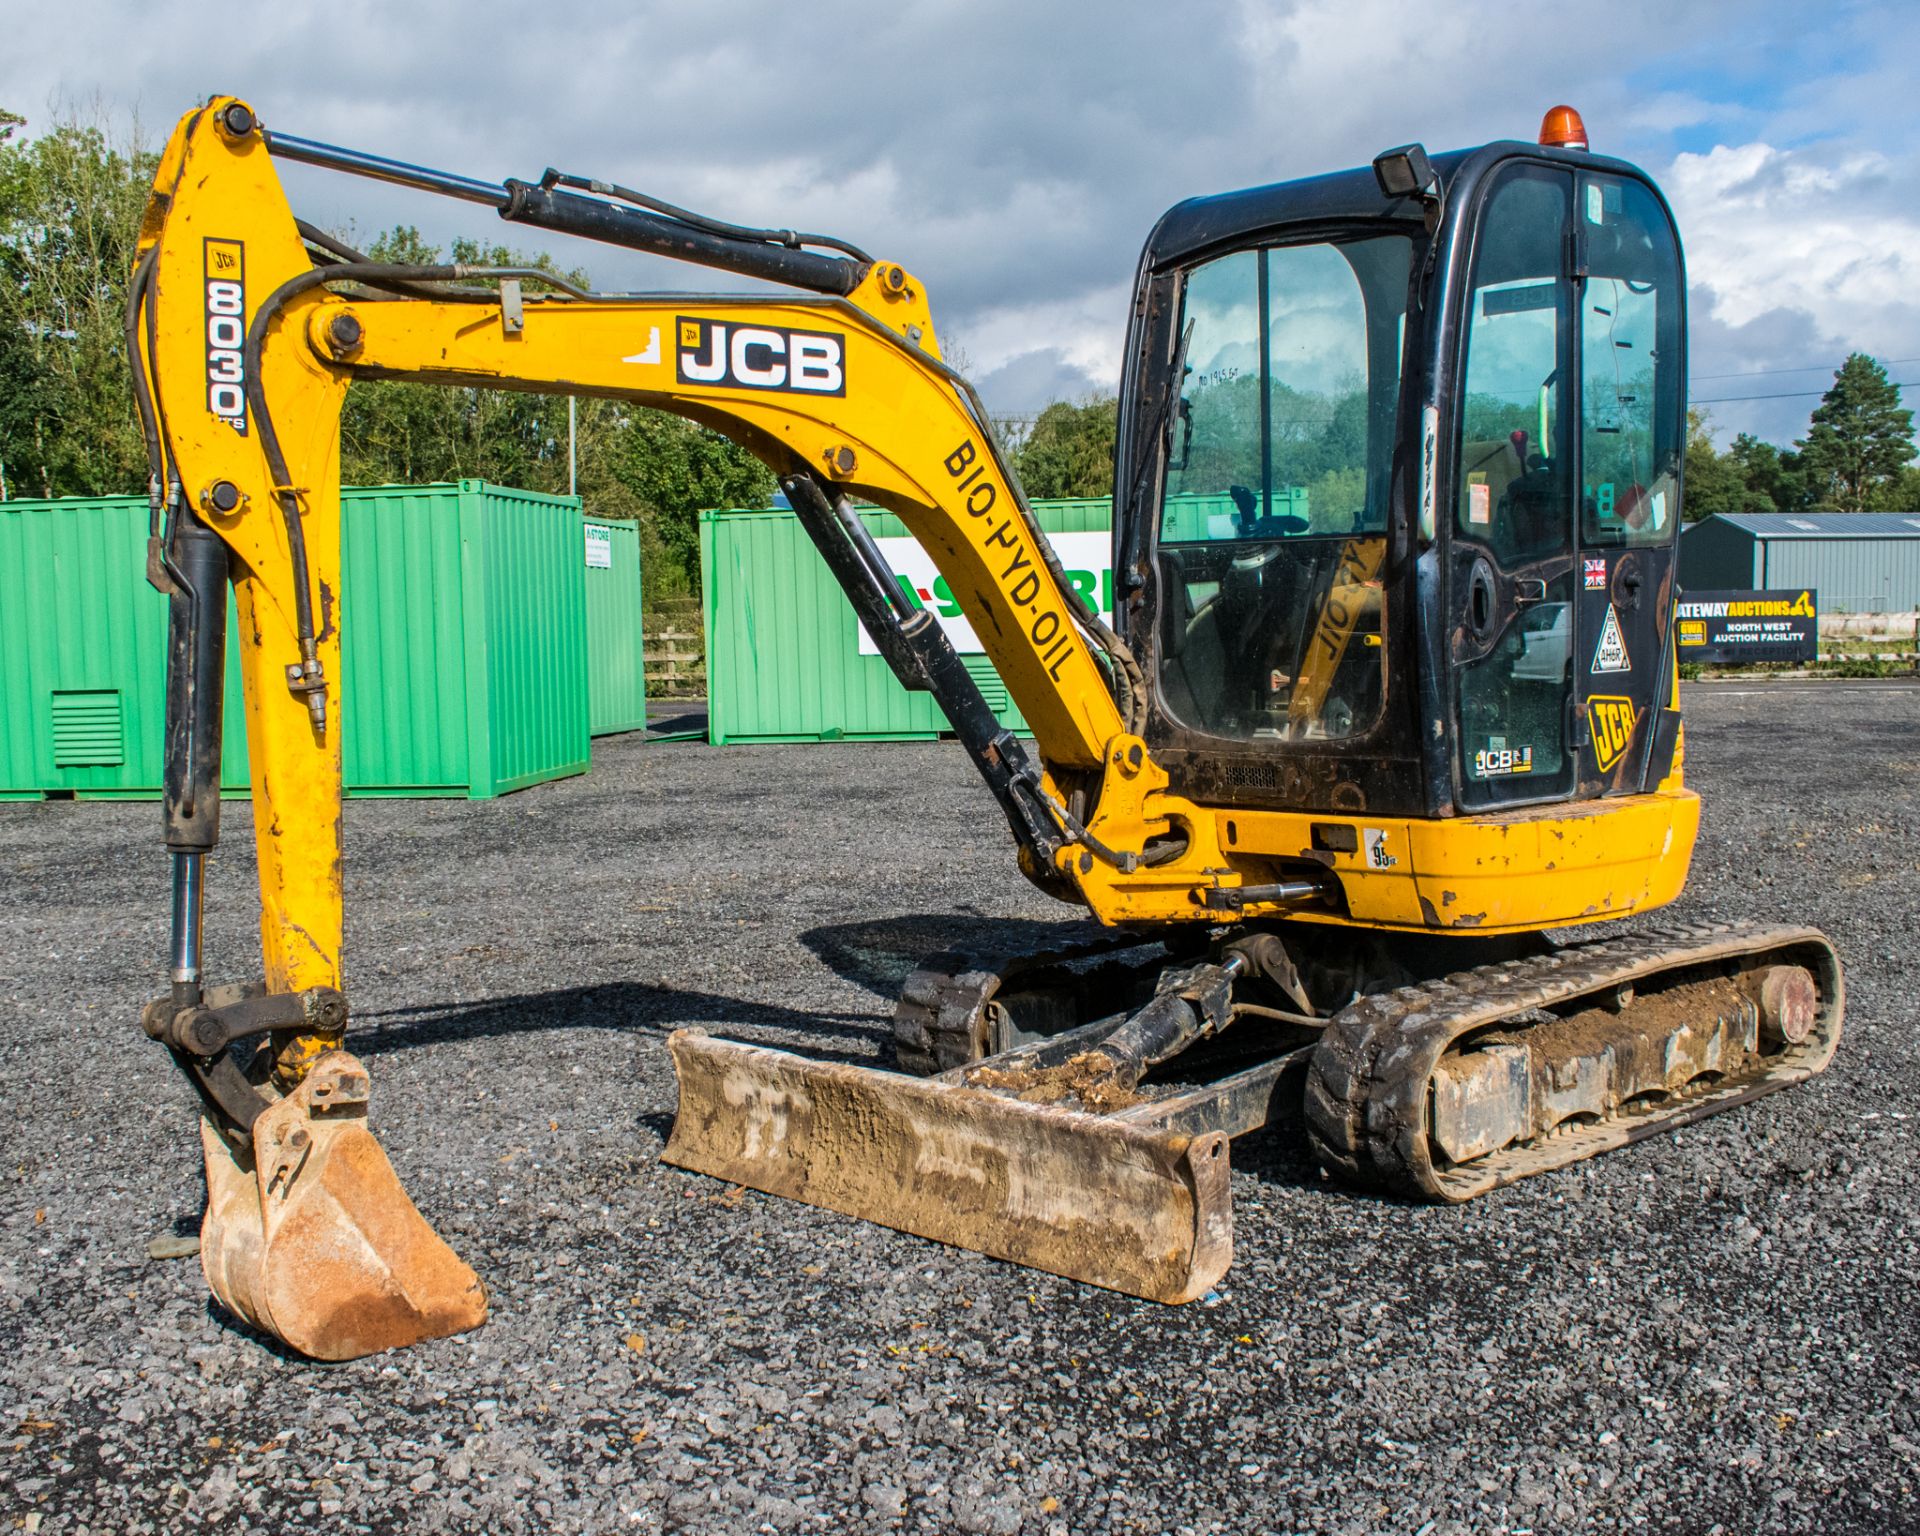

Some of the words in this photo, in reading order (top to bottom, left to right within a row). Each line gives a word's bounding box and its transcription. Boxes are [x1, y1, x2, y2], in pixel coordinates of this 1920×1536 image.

[216, 252, 236, 269] JCB
[208, 281, 244, 415] 8030
[681, 325, 842, 391] JCB
[944, 439, 1074, 683] BIO-HYD-OIL
[1727, 623, 1761, 632] NORTH
[1763, 622, 1792, 631] WEST
[1714, 634, 1758, 643] AUCTION
[1761, 632, 1805, 641] FACILITY
[1595, 703, 1633, 763] JCB
[1475, 750, 1512, 769] JCB
[1373, 846, 1390, 866] 95
